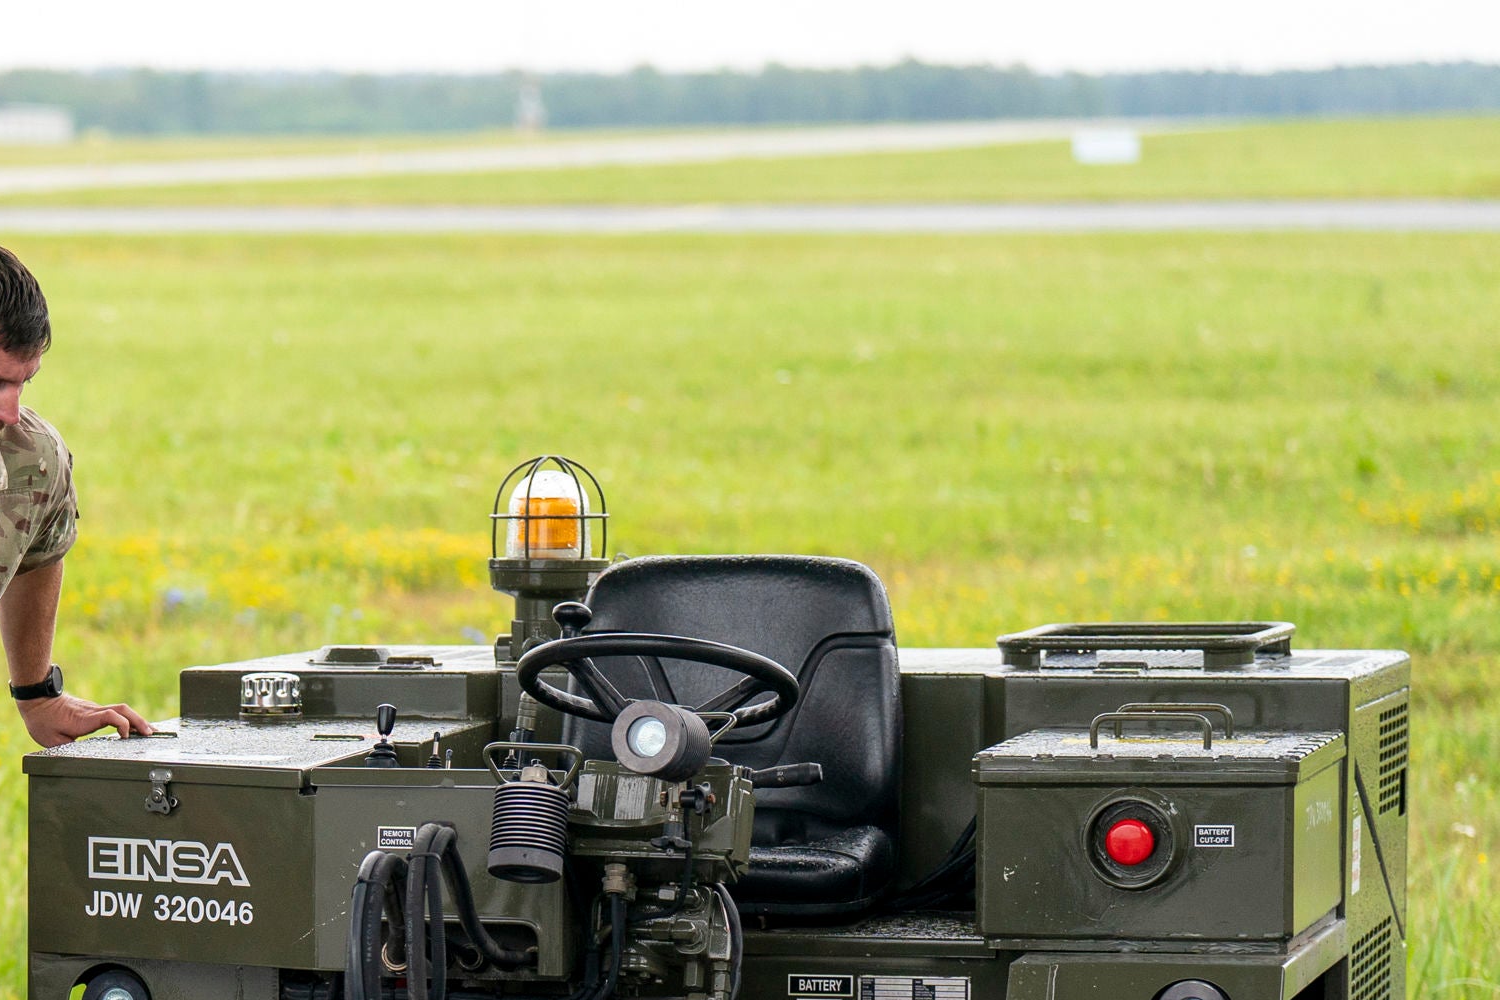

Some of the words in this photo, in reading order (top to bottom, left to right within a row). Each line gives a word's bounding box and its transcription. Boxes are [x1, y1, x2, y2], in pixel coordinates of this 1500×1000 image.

[382, 830, 412, 838] REMOTE
[1198, 828, 1231, 836] BATTERY
[380, 838, 414, 846] CONTROL
[1199, 836, 1230, 844] CUT-OFF
[88, 836, 251, 887] EINSA
[85, 890, 143, 919] JDW
[153, 894, 254, 926] 320046
[798, 978, 843, 992] BATTERY
